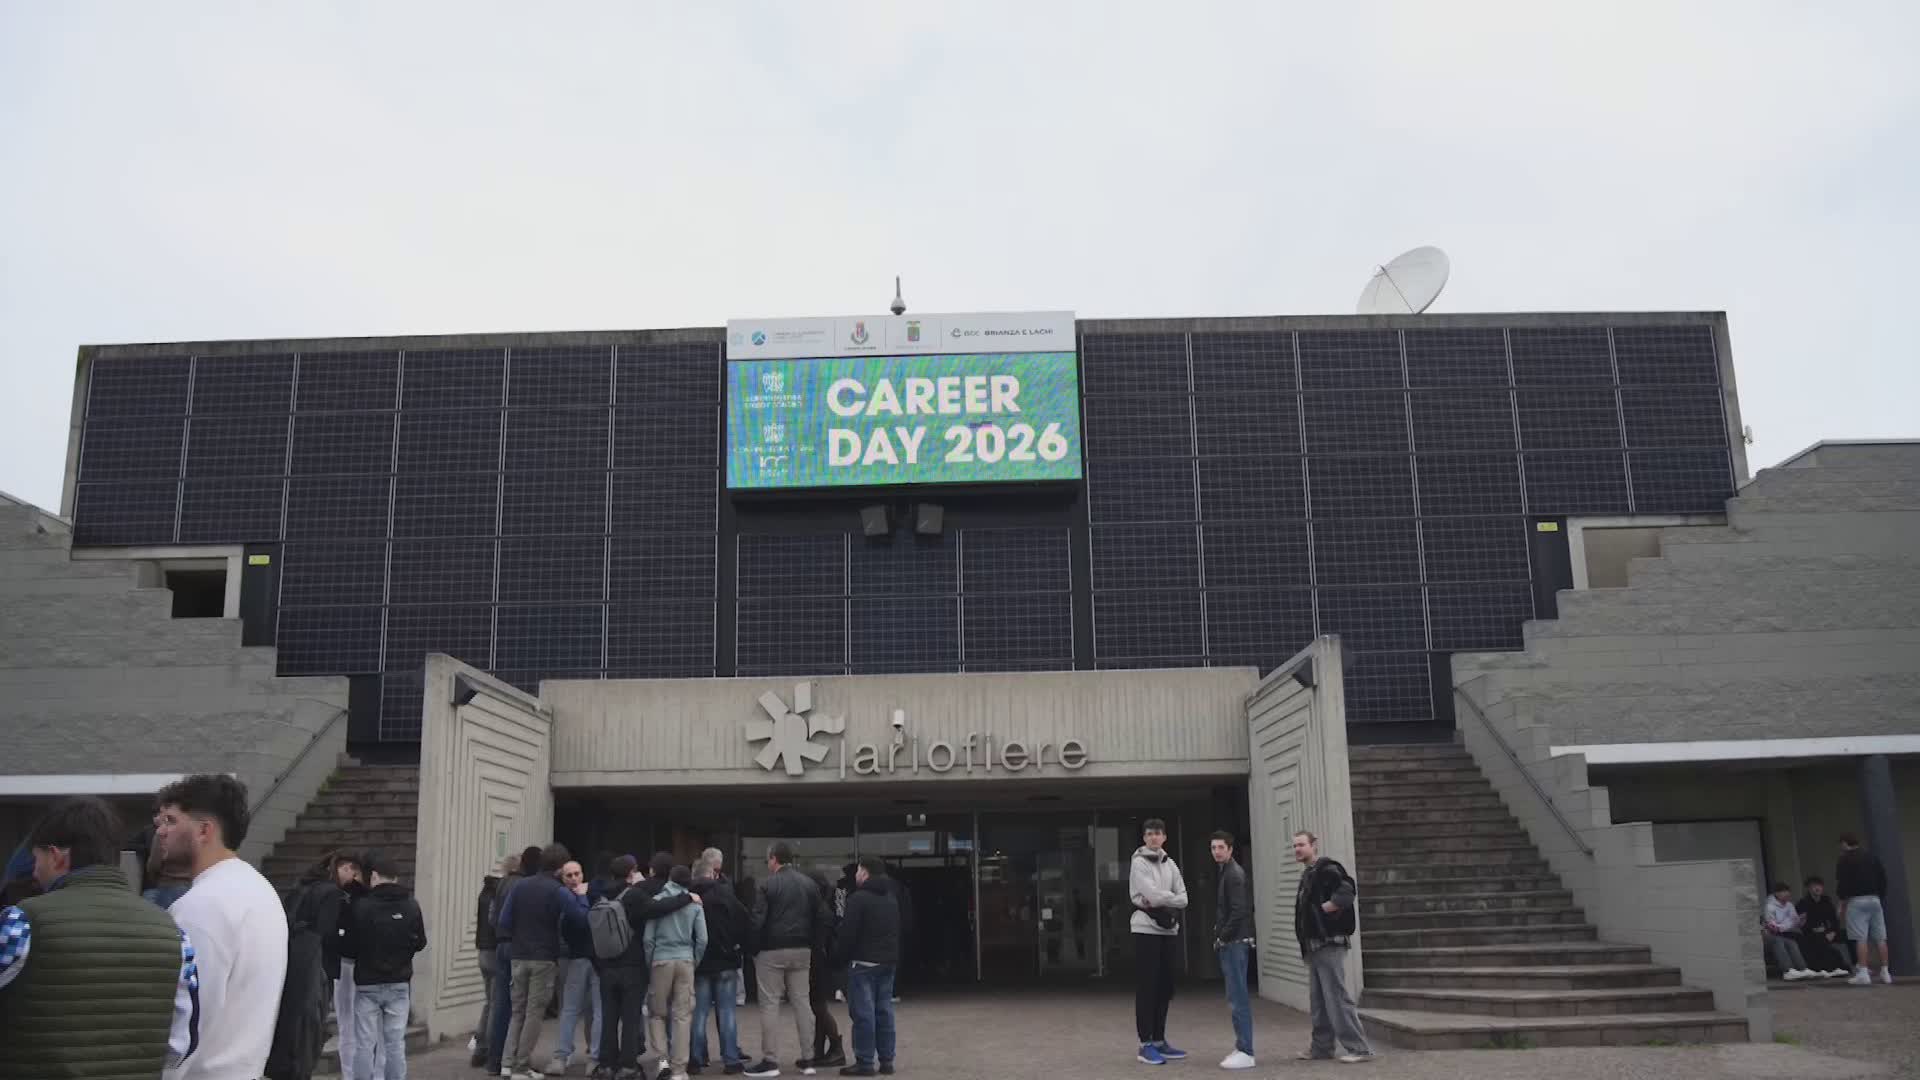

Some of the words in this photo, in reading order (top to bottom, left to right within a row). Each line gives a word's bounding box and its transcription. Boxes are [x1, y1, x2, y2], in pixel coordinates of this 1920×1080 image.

[827, 375, 1020, 416] CAREER
[828, 427, 926, 466] DAY
[944, 422, 1068, 463] 2026
[840, 732, 1087, 779] lariofiere
